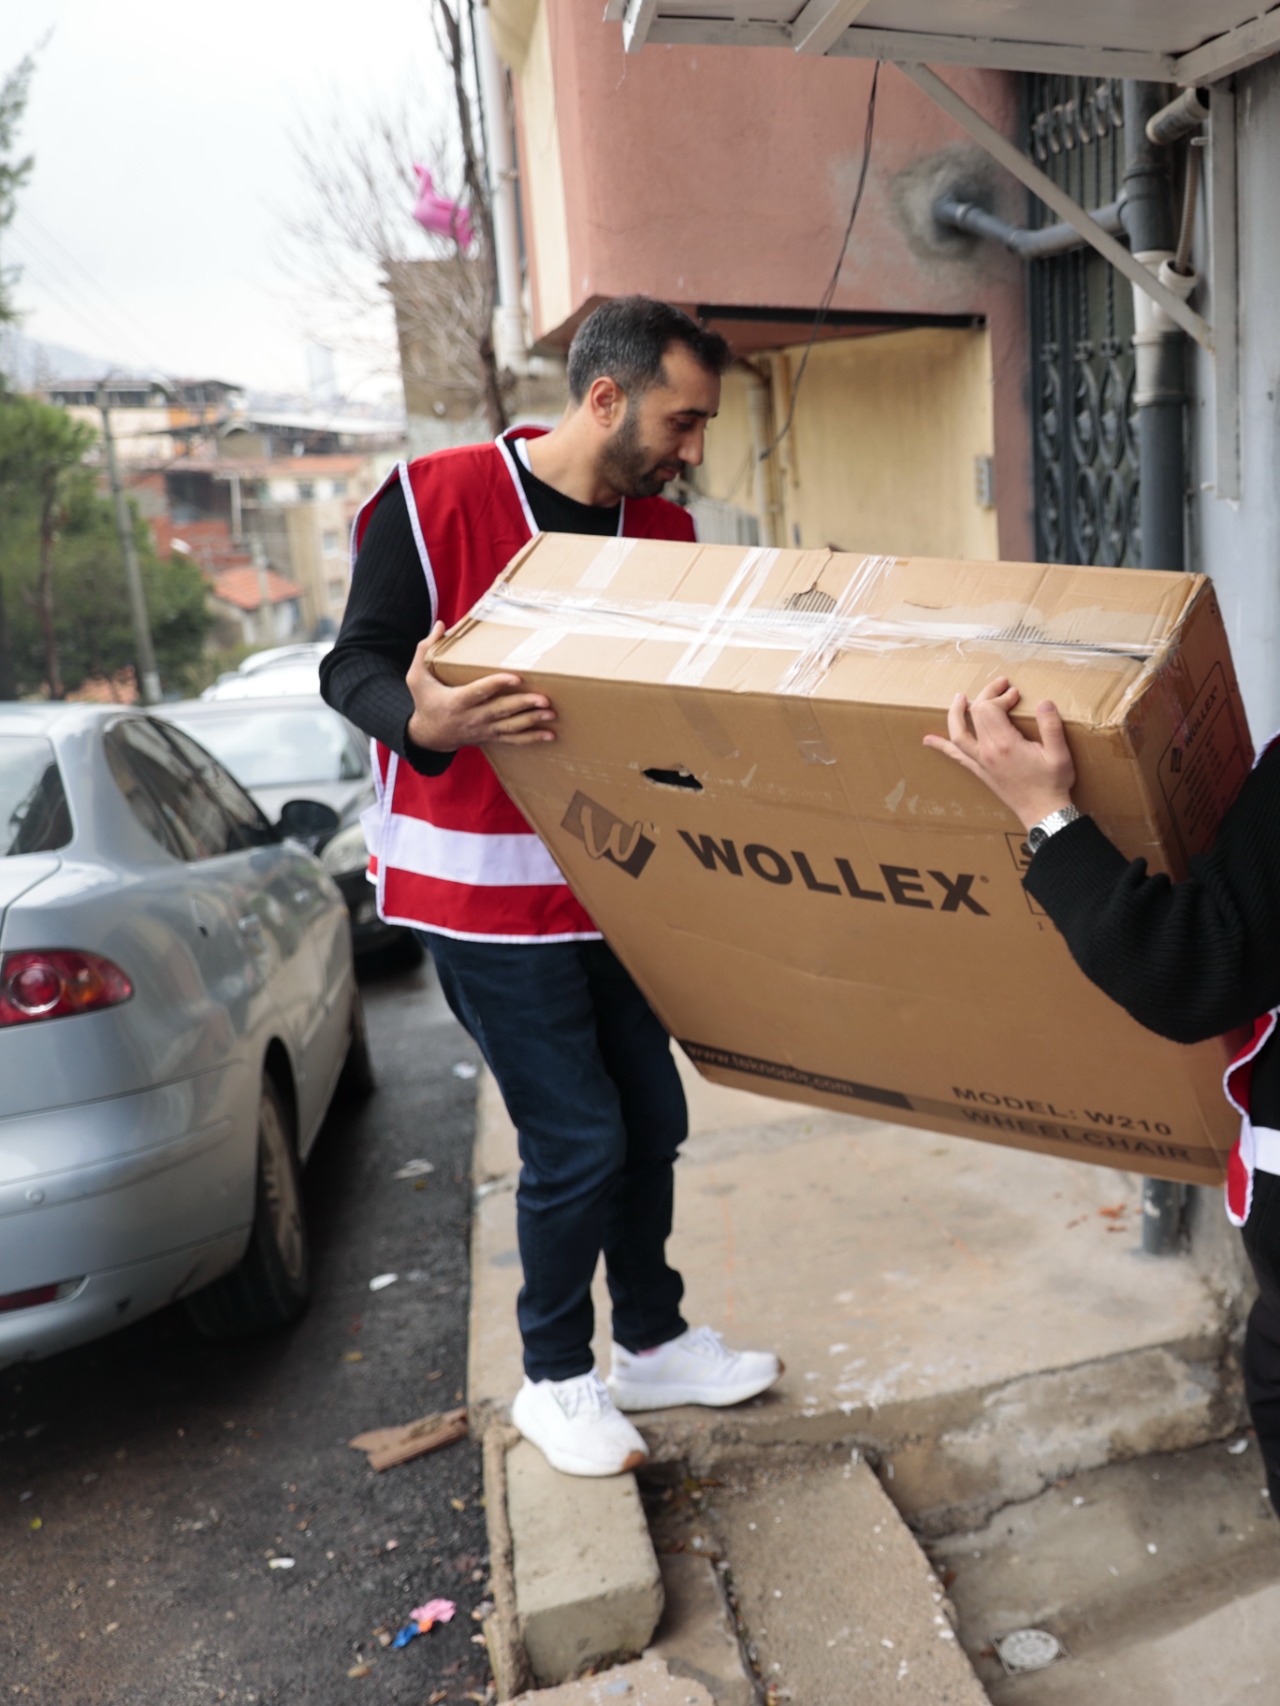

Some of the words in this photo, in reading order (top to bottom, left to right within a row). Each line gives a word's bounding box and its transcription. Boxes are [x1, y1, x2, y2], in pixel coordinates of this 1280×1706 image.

[1184, 691, 1216, 748] WOLLEX
[677, 829, 991, 916] WOLLEX
[951, 1086, 1077, 1120] MODEL:
[1083, 1109, 1172, 1136] W210
[960, 1108, 1192, 1161] WHEELCHAIR
